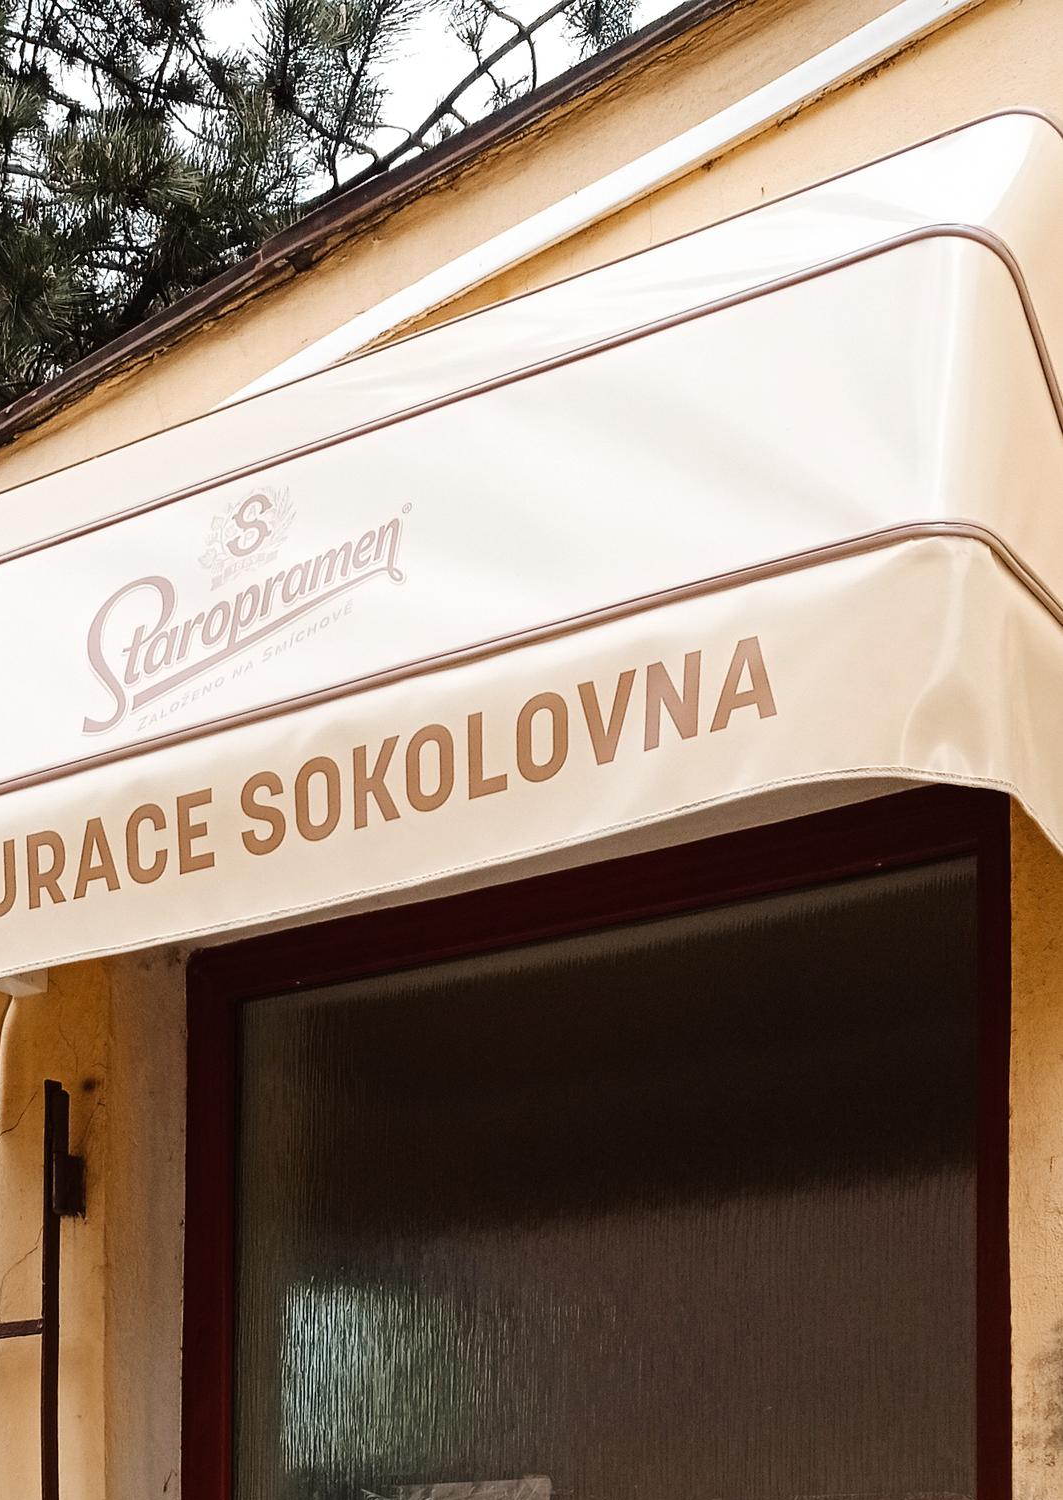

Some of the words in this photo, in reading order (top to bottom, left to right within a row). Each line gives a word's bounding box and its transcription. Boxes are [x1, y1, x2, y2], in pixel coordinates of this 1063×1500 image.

[82, 517, 405, 735] Staropramen
[137, 676, 225, 732] ZALOŽENO
[232, 660, 255, 681] NA
[240, 635, 778, 856] SOKOLOVNA
